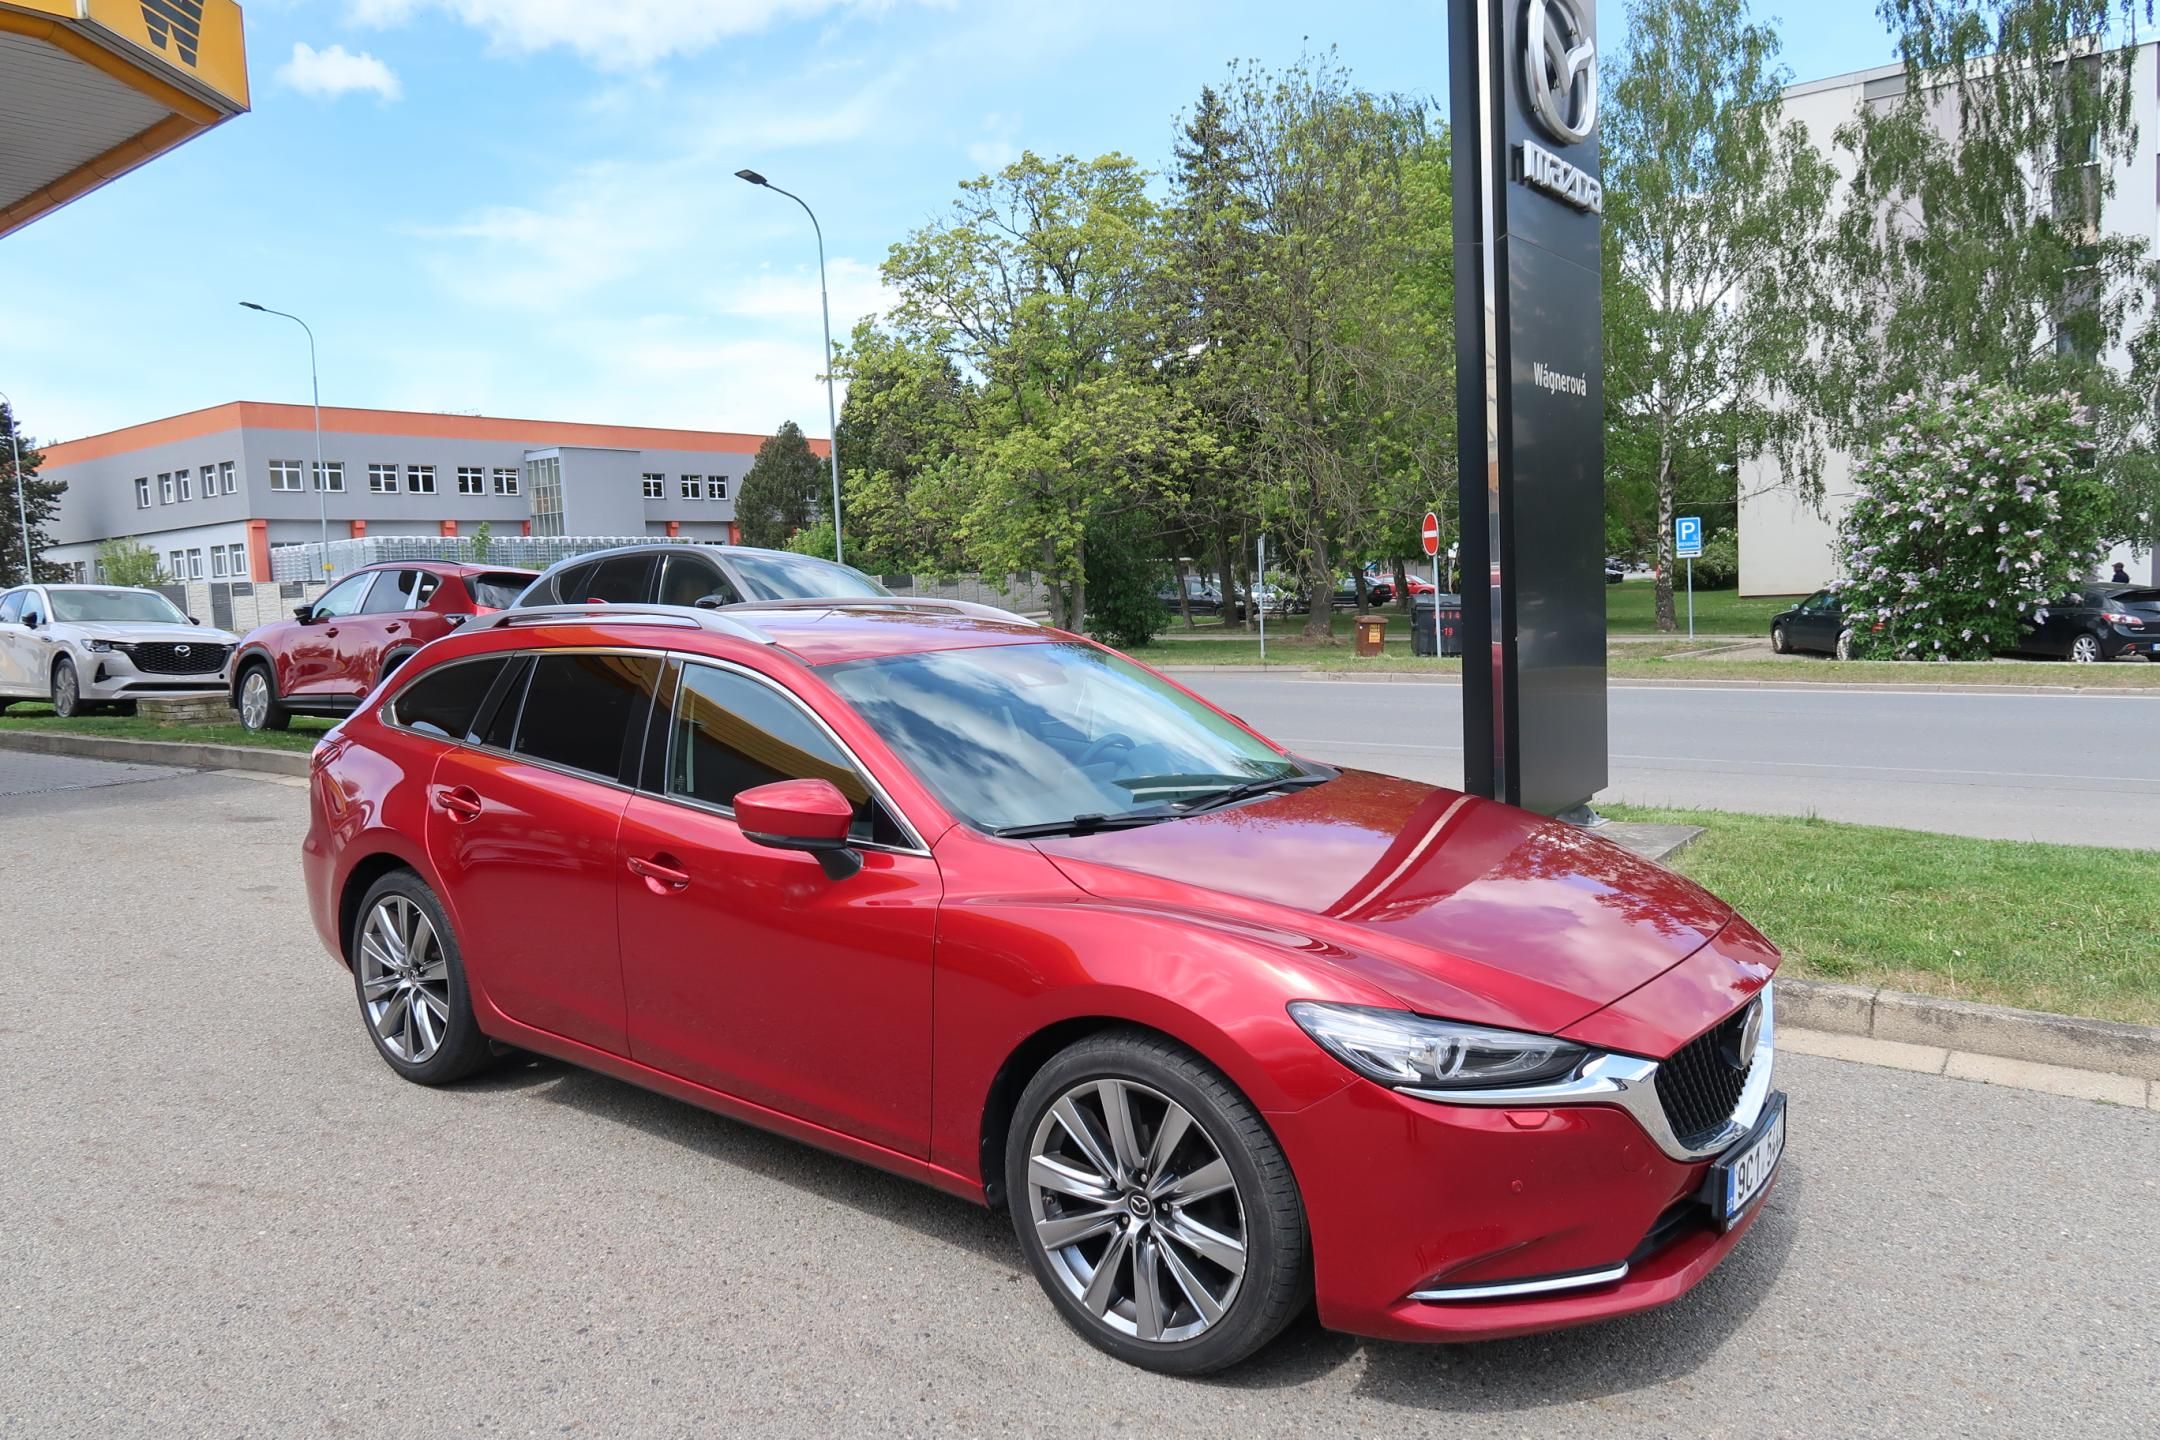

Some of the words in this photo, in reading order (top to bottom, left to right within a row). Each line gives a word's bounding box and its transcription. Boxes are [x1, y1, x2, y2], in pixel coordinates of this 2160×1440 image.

[1533, 361, 1587, 397] Wágnerová
[1681, 522, 1696, 540] P
[1737, 1146, 1760, 1199] 9C1
